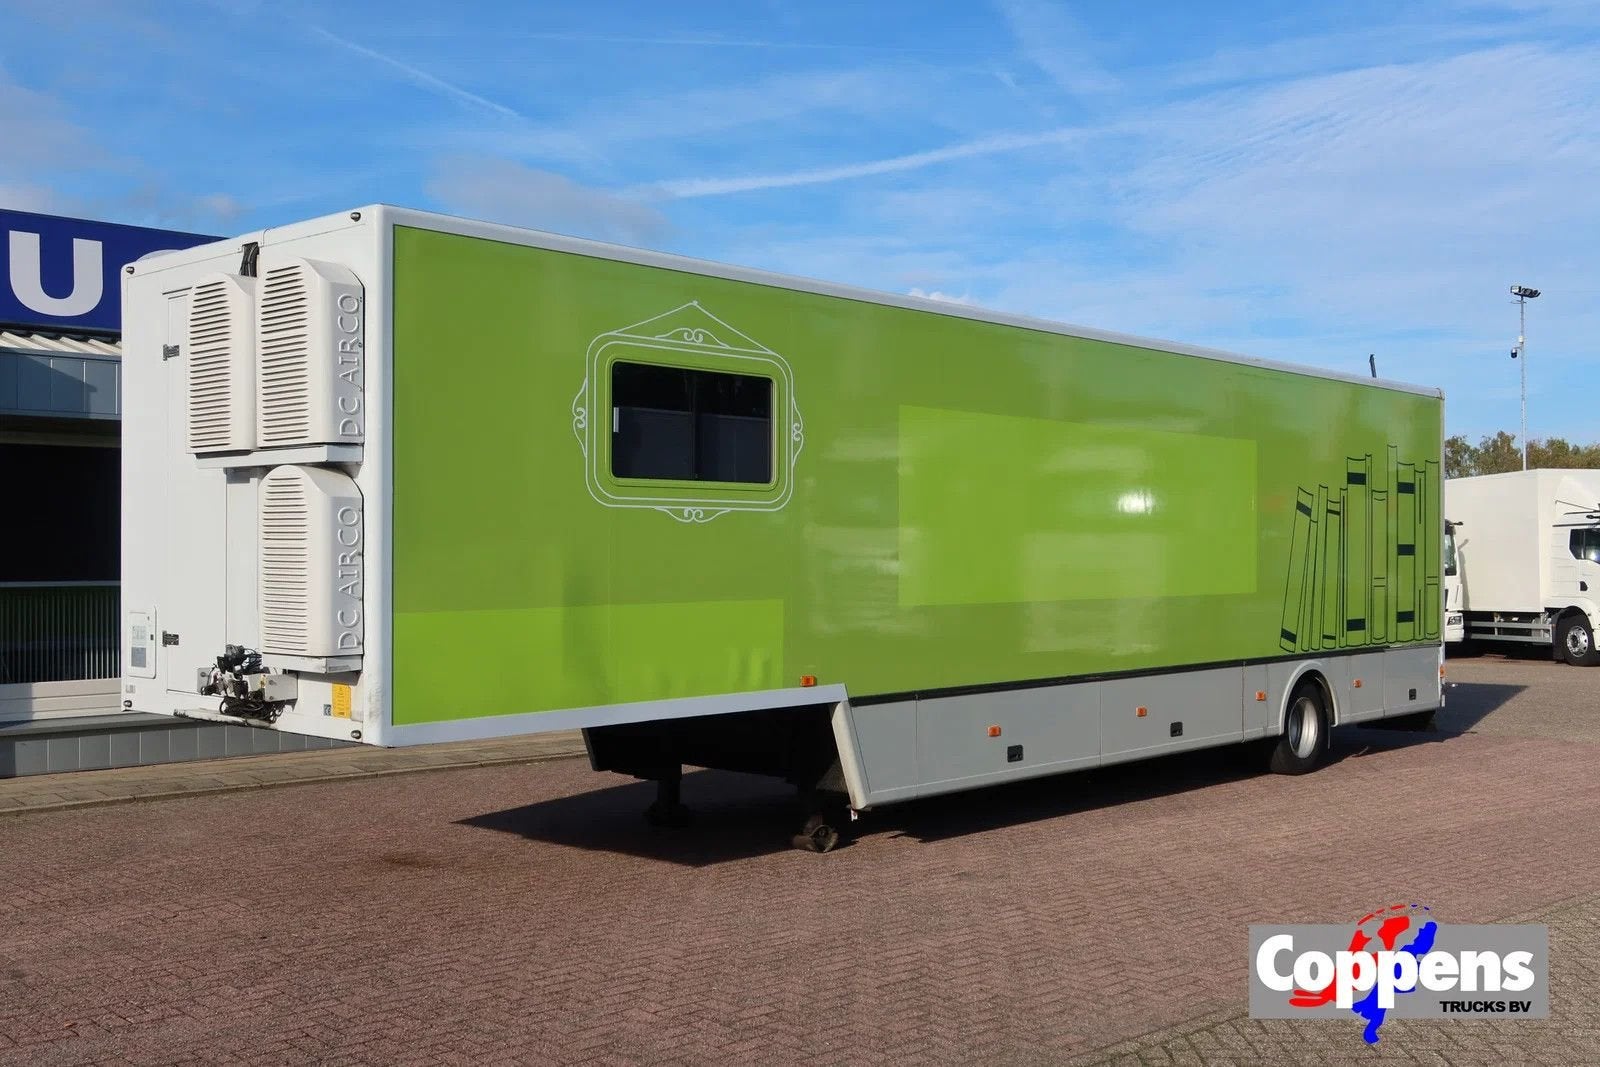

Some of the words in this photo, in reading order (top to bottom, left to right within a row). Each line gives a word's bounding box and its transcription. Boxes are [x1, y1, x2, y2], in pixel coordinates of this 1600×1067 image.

[338, 293, 360, 389] AIRCO
[338, 396, 360, 437] DC
[337, 506, 360, 600] AIRCO
[337, 609, 360, 650] DC
